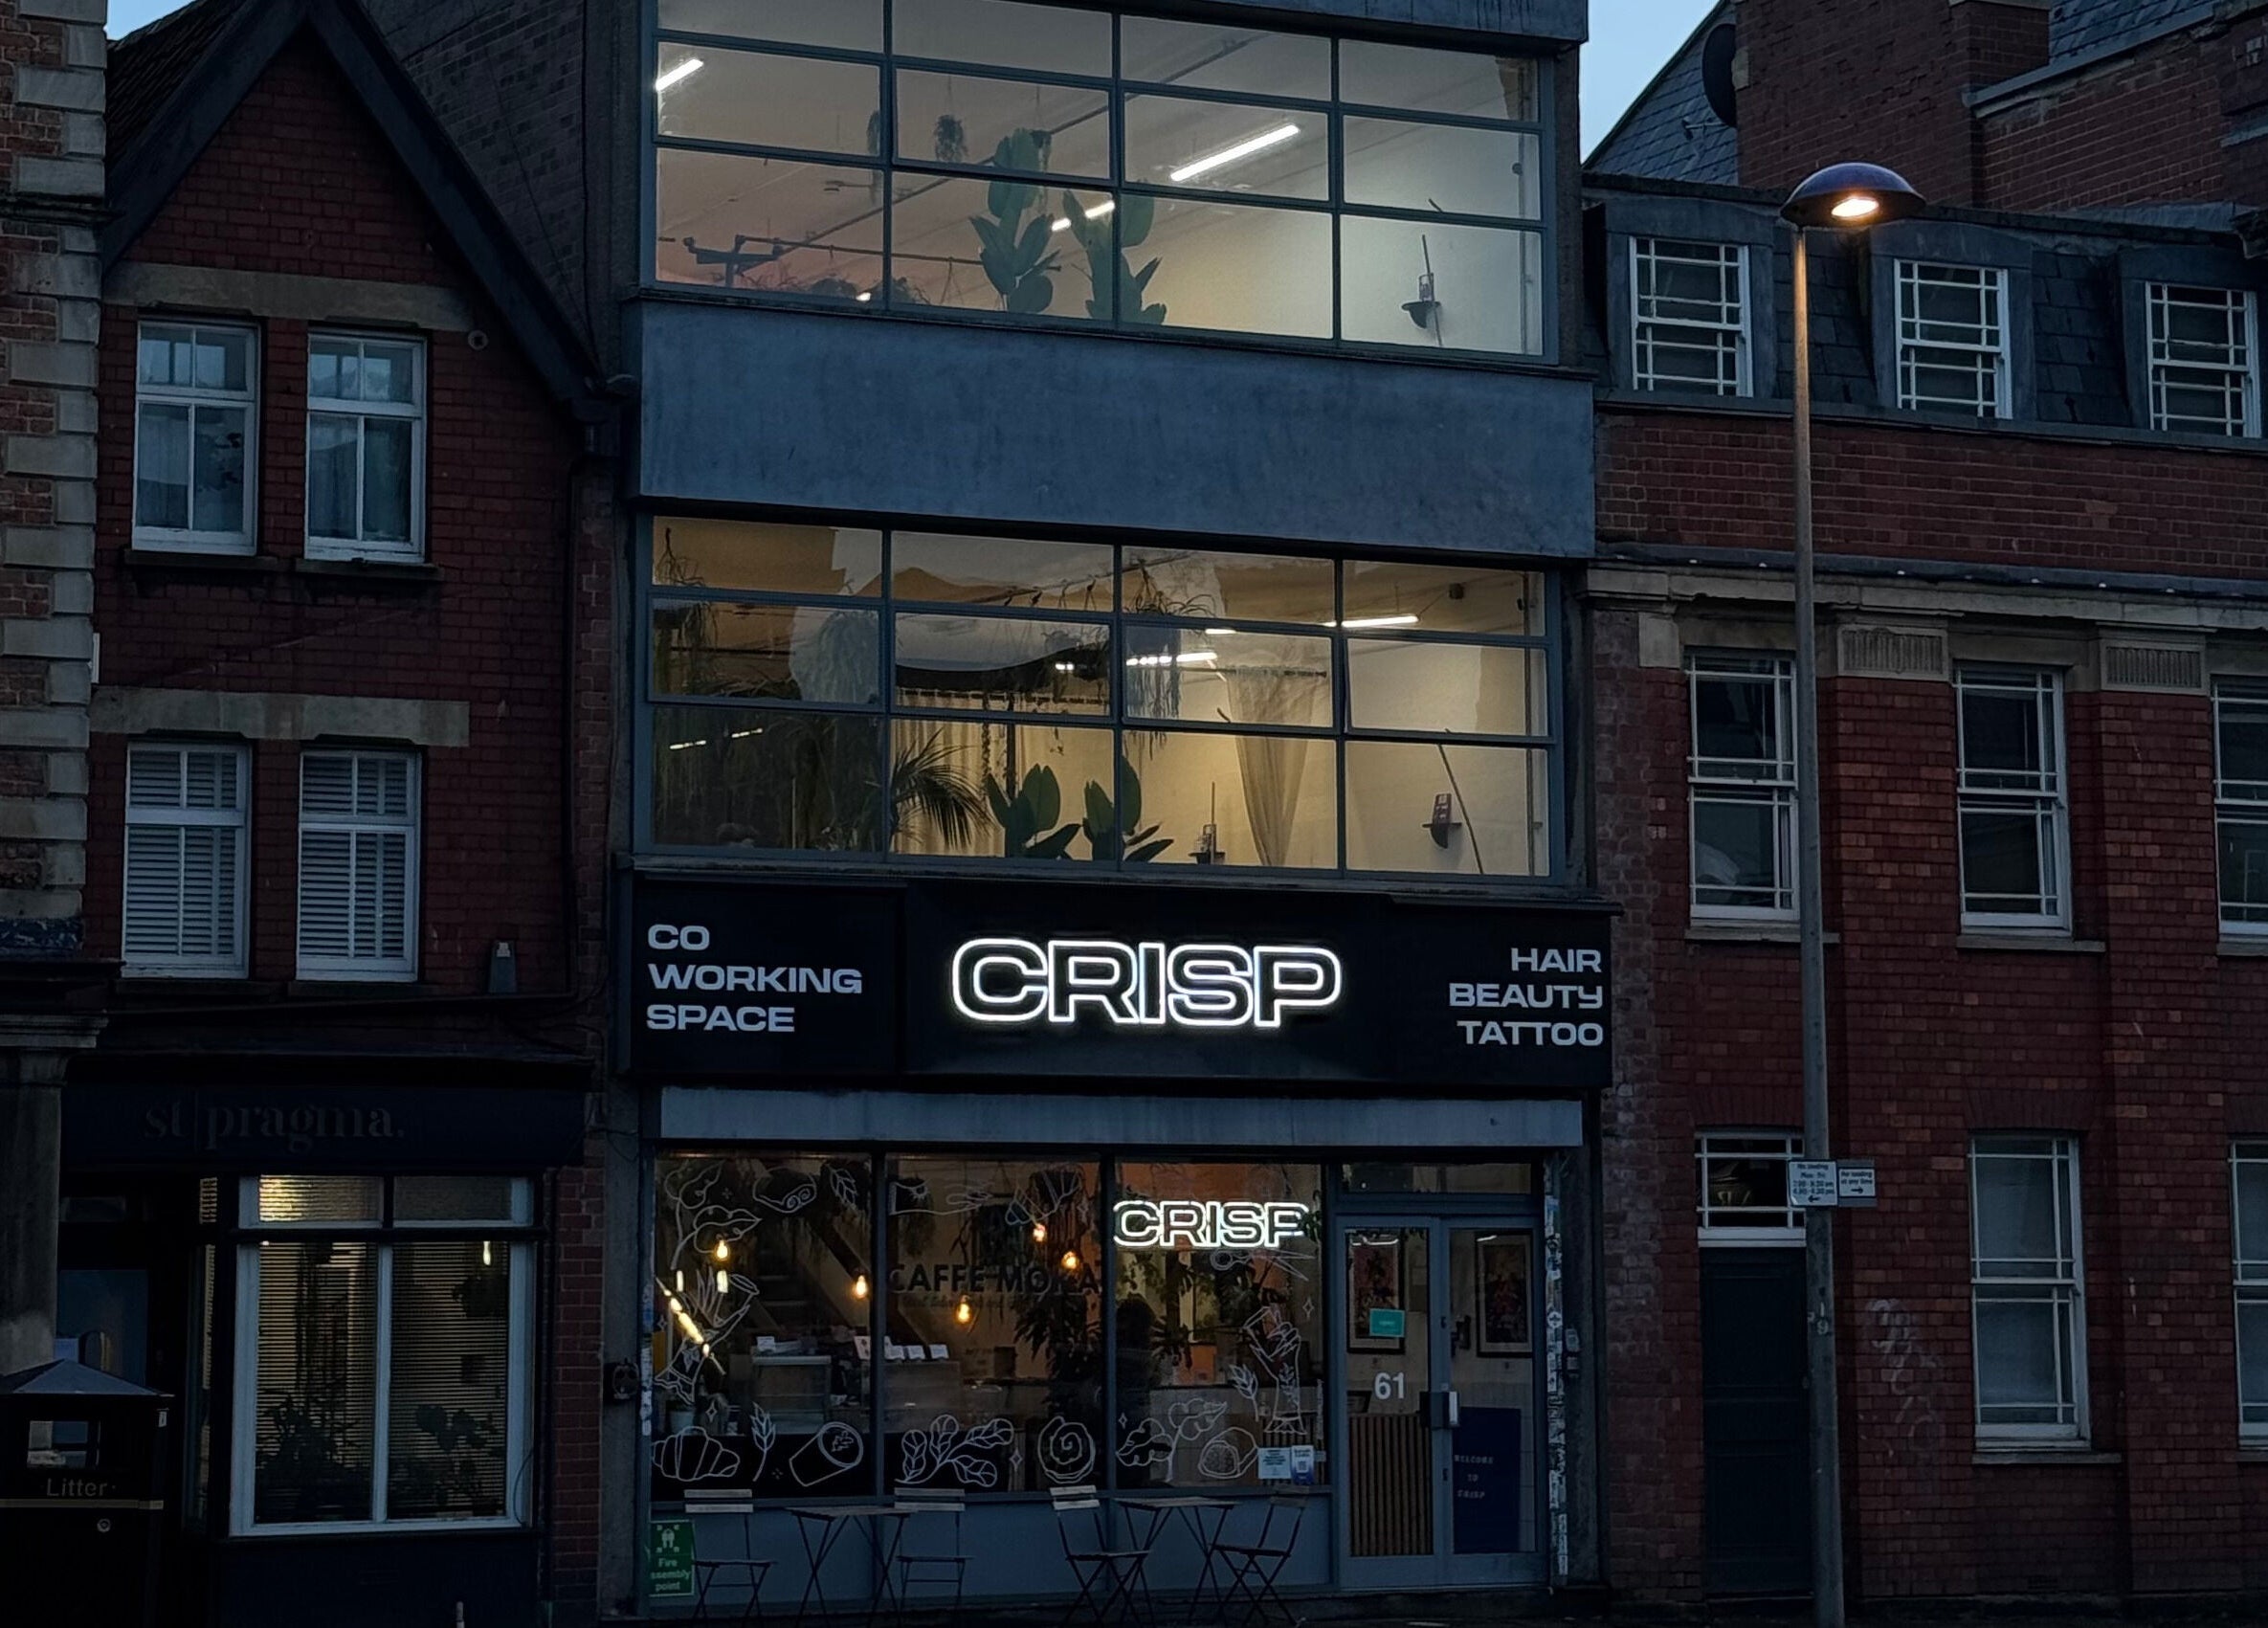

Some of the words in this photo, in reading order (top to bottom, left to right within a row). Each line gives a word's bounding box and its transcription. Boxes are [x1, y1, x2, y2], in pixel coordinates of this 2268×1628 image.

[648, 924, 710, 950] CO
[1511, 948, 1602, 973] HAIR
[648, 963, 862, 994] WORKING
[950, 936, 1344, 1030] CRISP
[1449, 982, 1603, 1010] BEAUTY
[646, 1004, 795, 1033] SPACE
[1456, 1020, 1604, 1046] TATTOO
[1114, 1200, 1309, 1247] CRISP
[1374, 1372, 1405, 1400] 61
[47, 1477, 108, 1497] Litter
[657, 1557, 678, 1569] Fire
[655, 1580, 680, 1593] point
